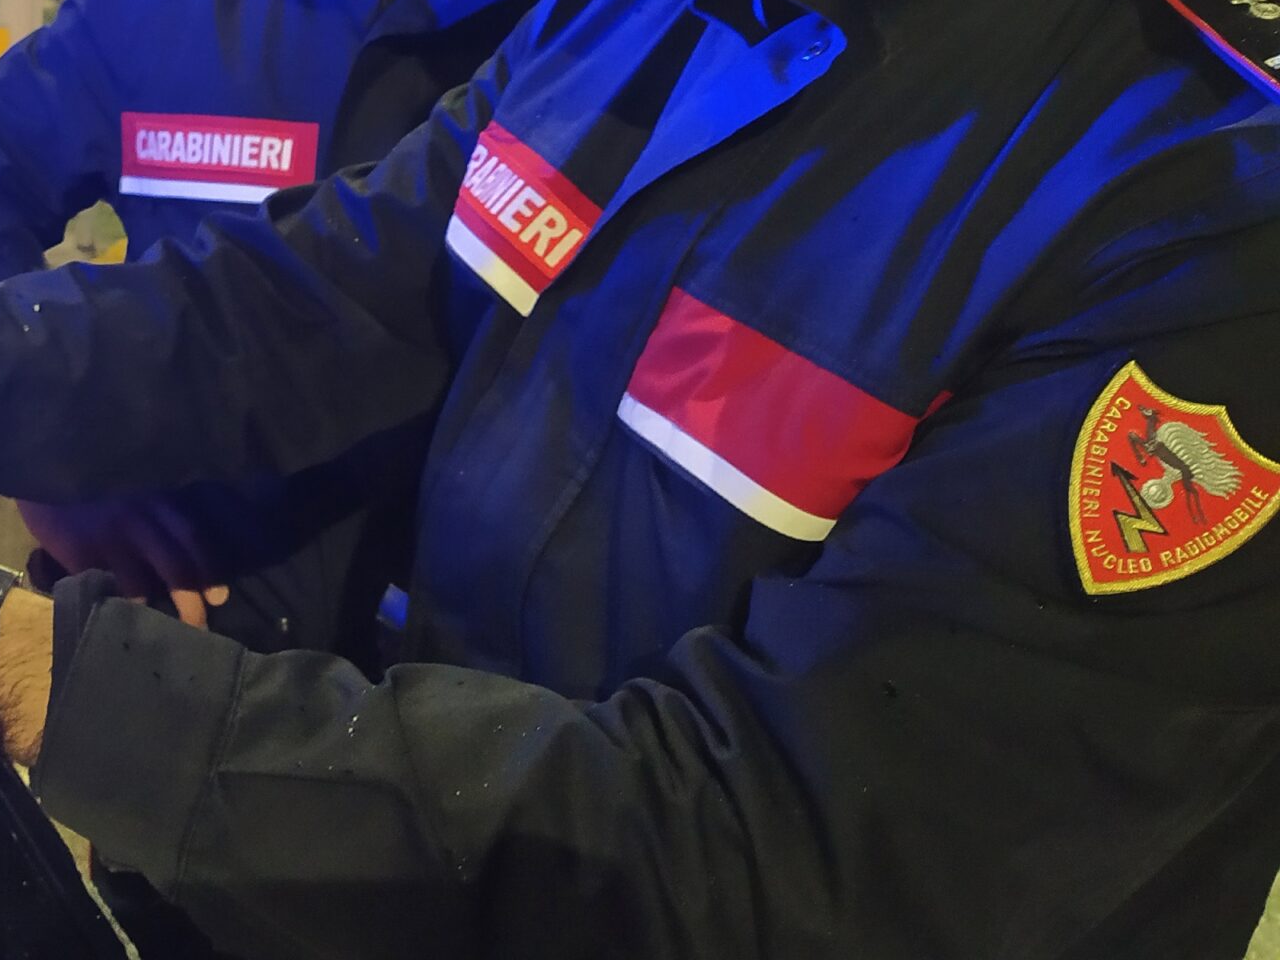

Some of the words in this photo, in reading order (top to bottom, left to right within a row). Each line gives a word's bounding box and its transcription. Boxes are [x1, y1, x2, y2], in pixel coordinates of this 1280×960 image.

[135, 128, 294, 172] CARABINIERI
[1081, 396, 1132, 518] CARABINIERI
[1086, 529, 1153, 574] NUCLEO
[1159, 486, 1270, 568] RADIOMOBILE
